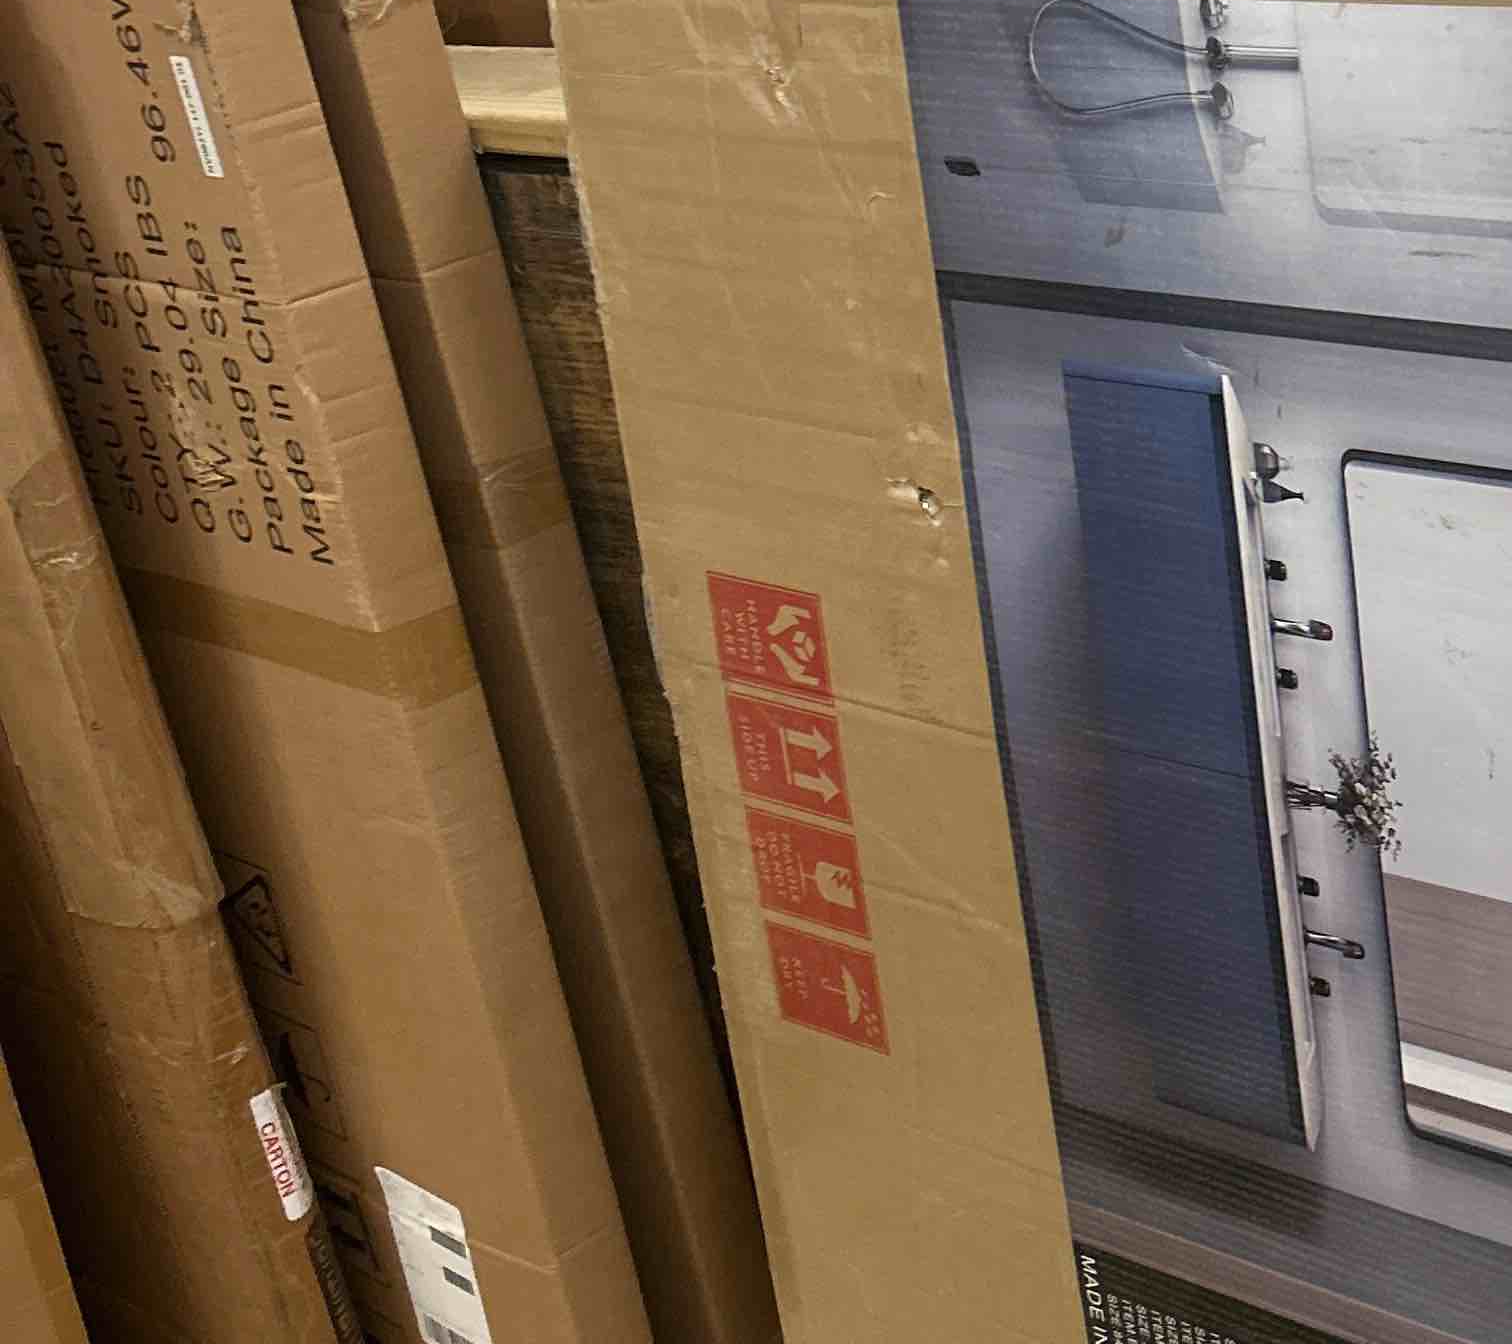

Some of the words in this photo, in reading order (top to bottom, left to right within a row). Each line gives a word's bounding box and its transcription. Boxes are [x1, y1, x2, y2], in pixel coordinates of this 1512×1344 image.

[43, 141, 118, 329] Smoked
[184, 222, 227, 337] Size:
[221, 226, 274, 364] China
[114, 250, 162, 353] PCS
[161, 277, 213, 404] 29.04
[122, 365, 179, 524] Colour:
[222, 358, 294, 554] Package
[268, 383, 294, 422] in
[285, 439, 334, 565] Made
[260, 1122, 296, 1198] CARTON
[1078, 1252, 1106, 1325] MADE
